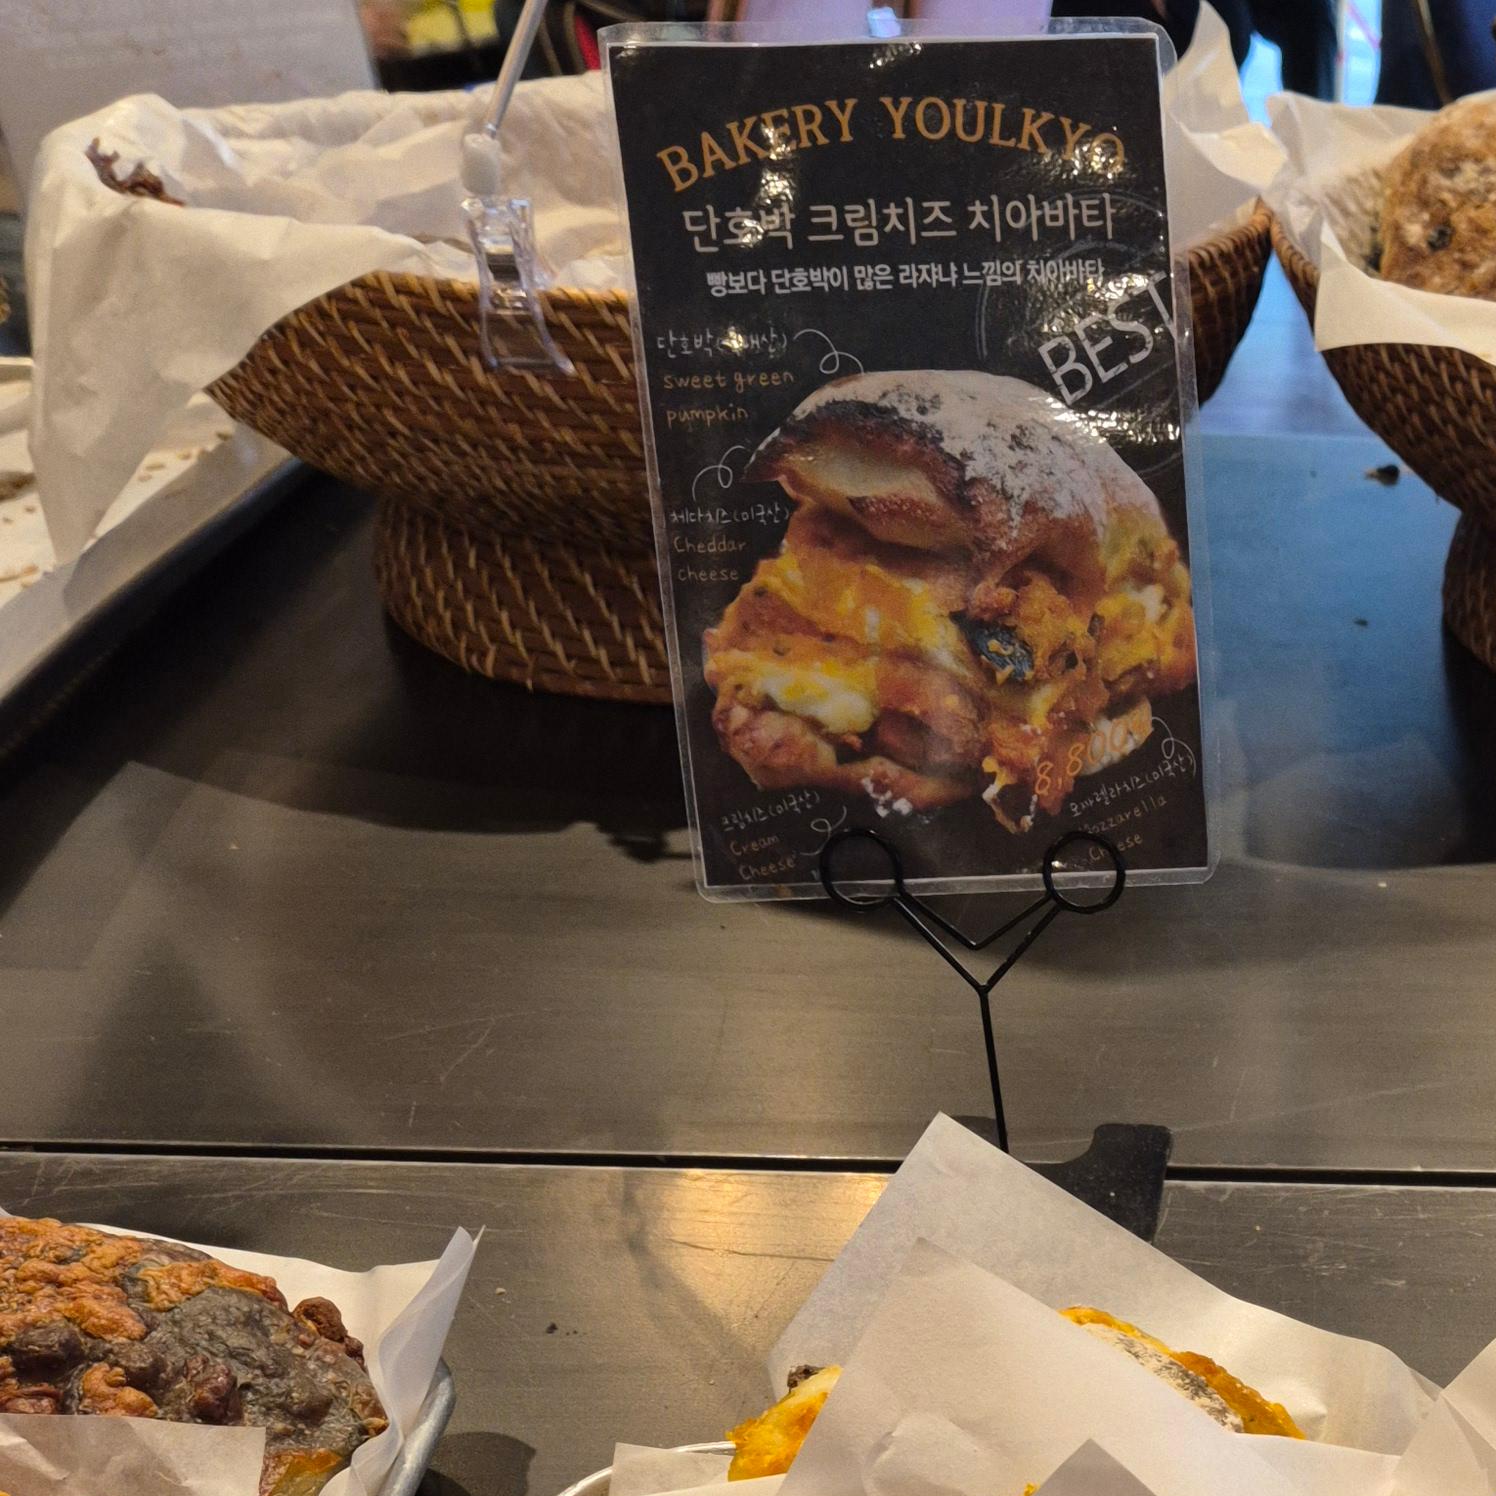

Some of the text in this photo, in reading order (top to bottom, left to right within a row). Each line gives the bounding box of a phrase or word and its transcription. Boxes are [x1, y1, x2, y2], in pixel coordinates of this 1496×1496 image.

[656, 96, 1125, 193] BAKERY YOULKYO
[682, 192, 1116, 253] 단호박 크림치즈 치아바타
[706, 258, 1105, 297] 빵보다 단호박이 많은 라쟈냐 느낌의 치아바타
[656, 327, 787, 358] 단호박(내산)
[1038, 271, 1177, 405] BEST
[664, 371, 795, 393] sweet green
[666, 403, 749, 430] pumpkin
[1088, 833, 1144, 861] Chese
